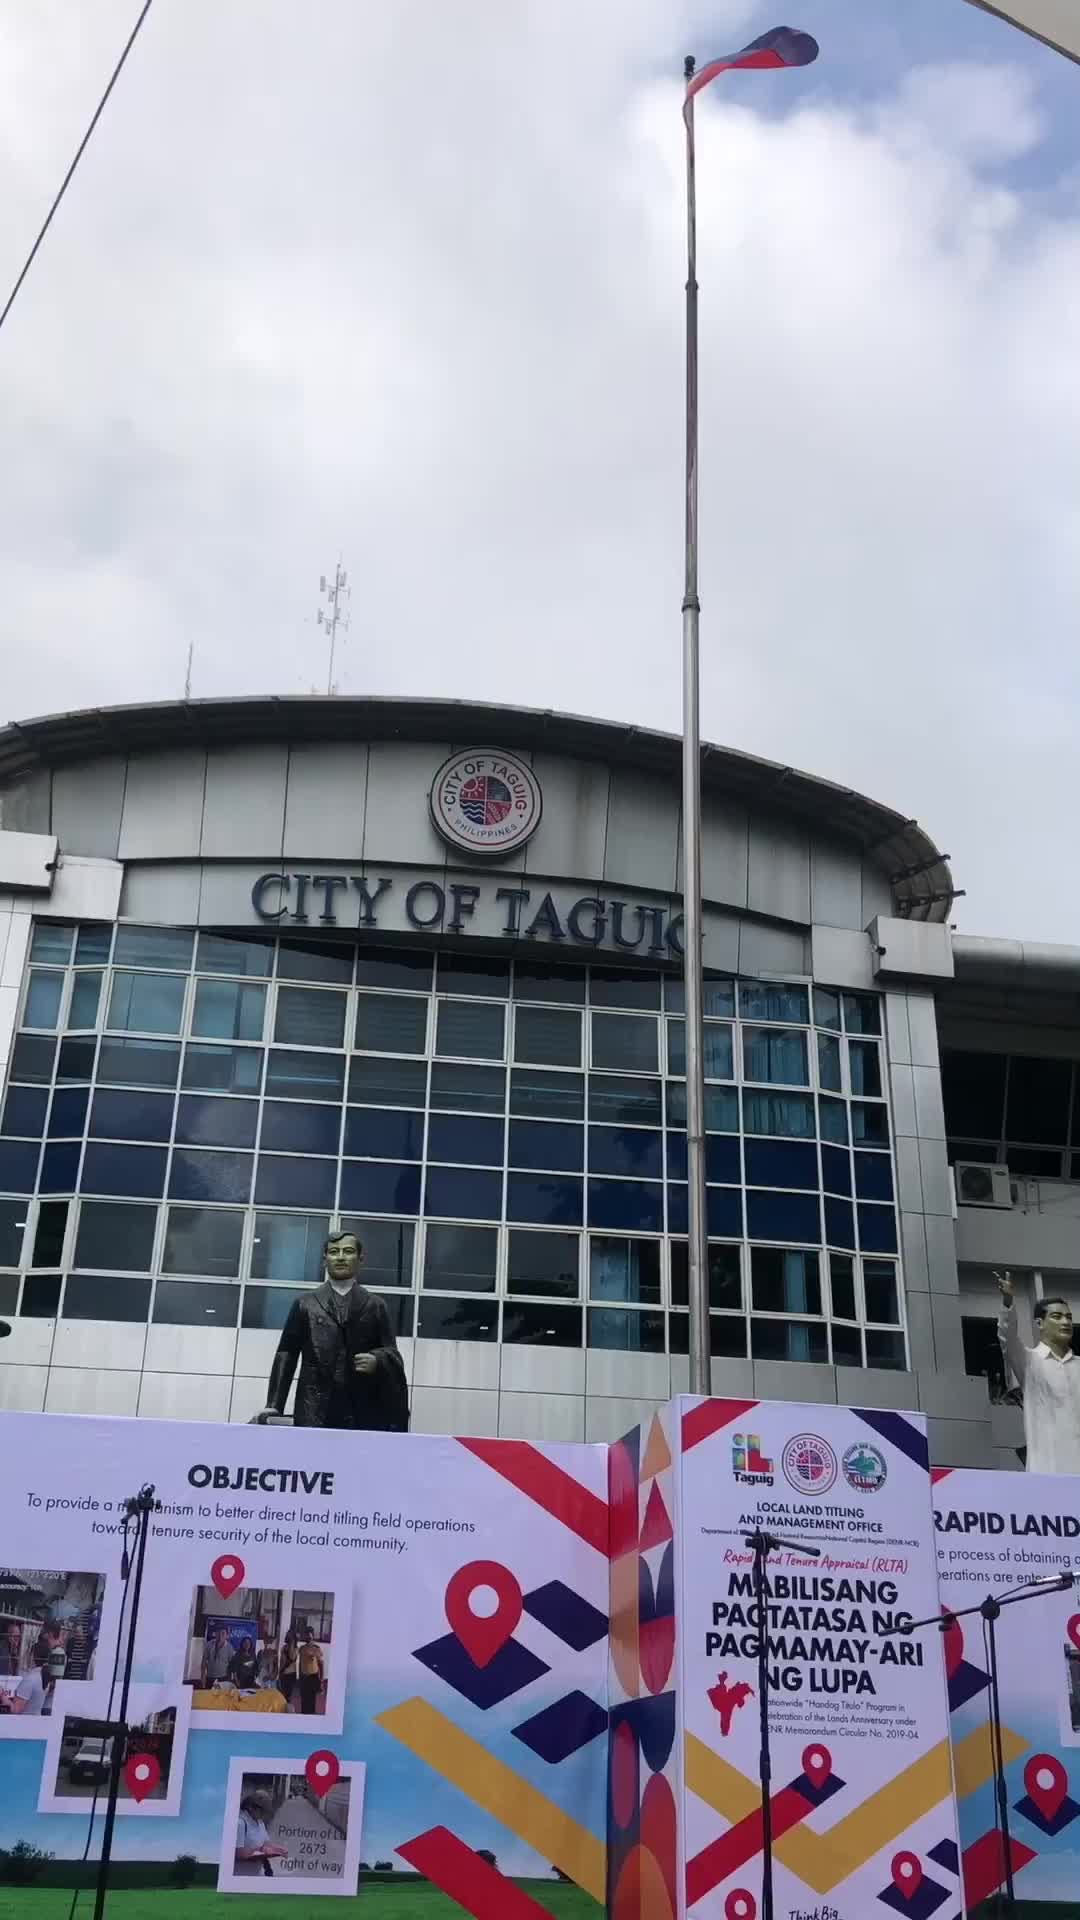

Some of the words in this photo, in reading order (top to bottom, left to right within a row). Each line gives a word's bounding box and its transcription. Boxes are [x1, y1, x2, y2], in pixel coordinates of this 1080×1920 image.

[444, 772, 462, 805] CITY
[464, 761, 485, 775] OF
[491, 761, 527, 810] TAGUIG
[455, 819, 518, 838] PHILIPPINES
[251, 873, 392, 924] CITY
[405, 881, 480, 930] OF
[788, 1448, 798, 1467] CITY
[797, 1441, 807, 1450] OF
[188, 1464, 334, 1495] OBJECTIVE
[733, 1472, 774, 1486] Taguig
[27, 1493, 42, 1507] To
[46, 1496, 99, 1511] provide
[103, 1502, 113, 1511] a
[118, 1499, 193, 1516] manism
[199, 1504, 211, 1517] to
[216, 1502, 254, 1519] better
[258, 1506, 296, 1521] direct
[300, 1508, 329, 1523] land
[333, 1510, 368, 1529] titling
[373, 1512, 401, 1528] field
[405, 1519, 476, 1533] operations
[757, 1502, 790, 1514] LOCAL
[793, 1504, 822, 1516] LAND
[825, 1506, 864, 1519] TITLING
[738, 1514, 763, 1526] AND
[766, 1516, 845, 1531] MANAGEMENT
[847, 1521, 883, 1533] OFFICE
[933, 1510, 1005, 1534] RAPID
[1010, 1514, 1080, 1538] LAND
[152, 1525, 194, 1539] tenure
[198, 1528, 250, 1545] security
[254, 1528, 269, 1543] of
[272, 1529, 292, 1544] the
[296, 1530, 329, 1546] local
[333, 1537, 408, 1554] community.
[786, 1556, 819, 1568] Tenure
[820, 1555, 869, 1570] Appraisal
[872, 1558, 908, 1574] (RLTA)
[949, 1550, 996, 1564] process
[998, 1548, 1011, 1561] of
[1014, 1548, 1071, 1567] obtaining
[993, 1573, 1013, 1583] are
[728, 1573, 898, 1605] MABILISANG
[872, 1610, 914, 1635] NG
[705, 1632, 923, 1666] PAGMAMAY-ARI
[762, 1666, 803, 1692] NG
[809, 1668, 876, 1695] LUPA
[767, 1698, 803, 1708] ationwide
[866, 1702, 897, 1713] Program
[898, 1704, 905, 1712] in
[767, 1711, 803, 1721] elebration
[805, 1711, 813, 1721] of
[814, 1712, 826, 1722] the
[828, 1714, 848, 1723] Lands
[850, 1715, 893, 1726] Anniversary
[895, 1717, 917, 1726] under
[767, 1725, 784, 1734] ENR
[785, 1726, 838, 1736] Memorandum
[839, 1727, 867, 1738] Circular
[869, 1729, 883, 1738] No.
[886, 1729, 919, 1740] 2019-04
[278, 1825, 317, 1839] Portion
[319, 1828, 331, 1840] of
[300, 1842, 327, 1855] 2673
[281, 1859, 305, 1872] right
[307, 1860, 319, 1871] of
[321, 1863, 343, 1876] way
